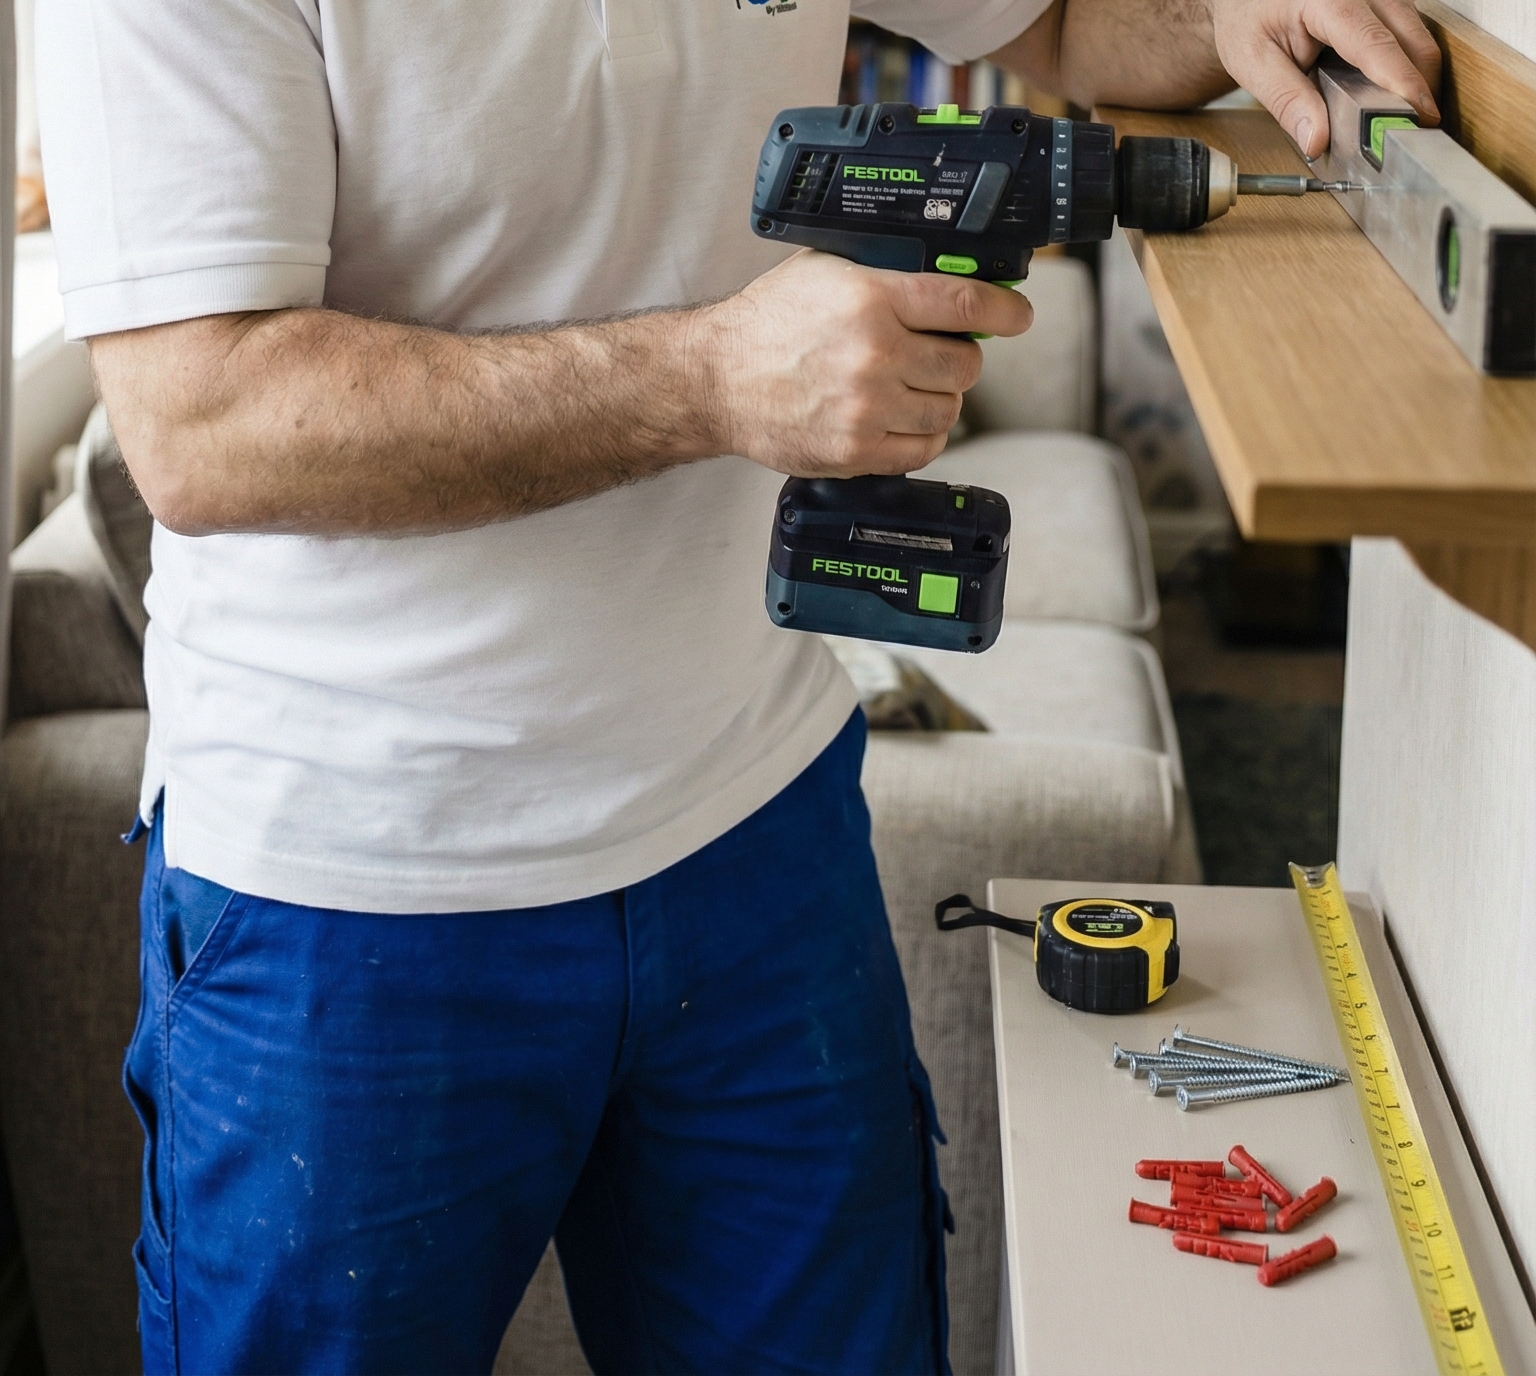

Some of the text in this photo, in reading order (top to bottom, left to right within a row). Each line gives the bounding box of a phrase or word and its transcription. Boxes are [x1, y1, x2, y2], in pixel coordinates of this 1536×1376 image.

[843, 165, 925, 183] FESTOOL
[812, 558, 909, 584] FESTOOL
[1354, 1001, 1367, 1010] 5
[1410, 1179, 1426, 1188] 9
[1423, 1222, 1442, 1238] 10
[1437, 1264, 1455, 1280] 11
